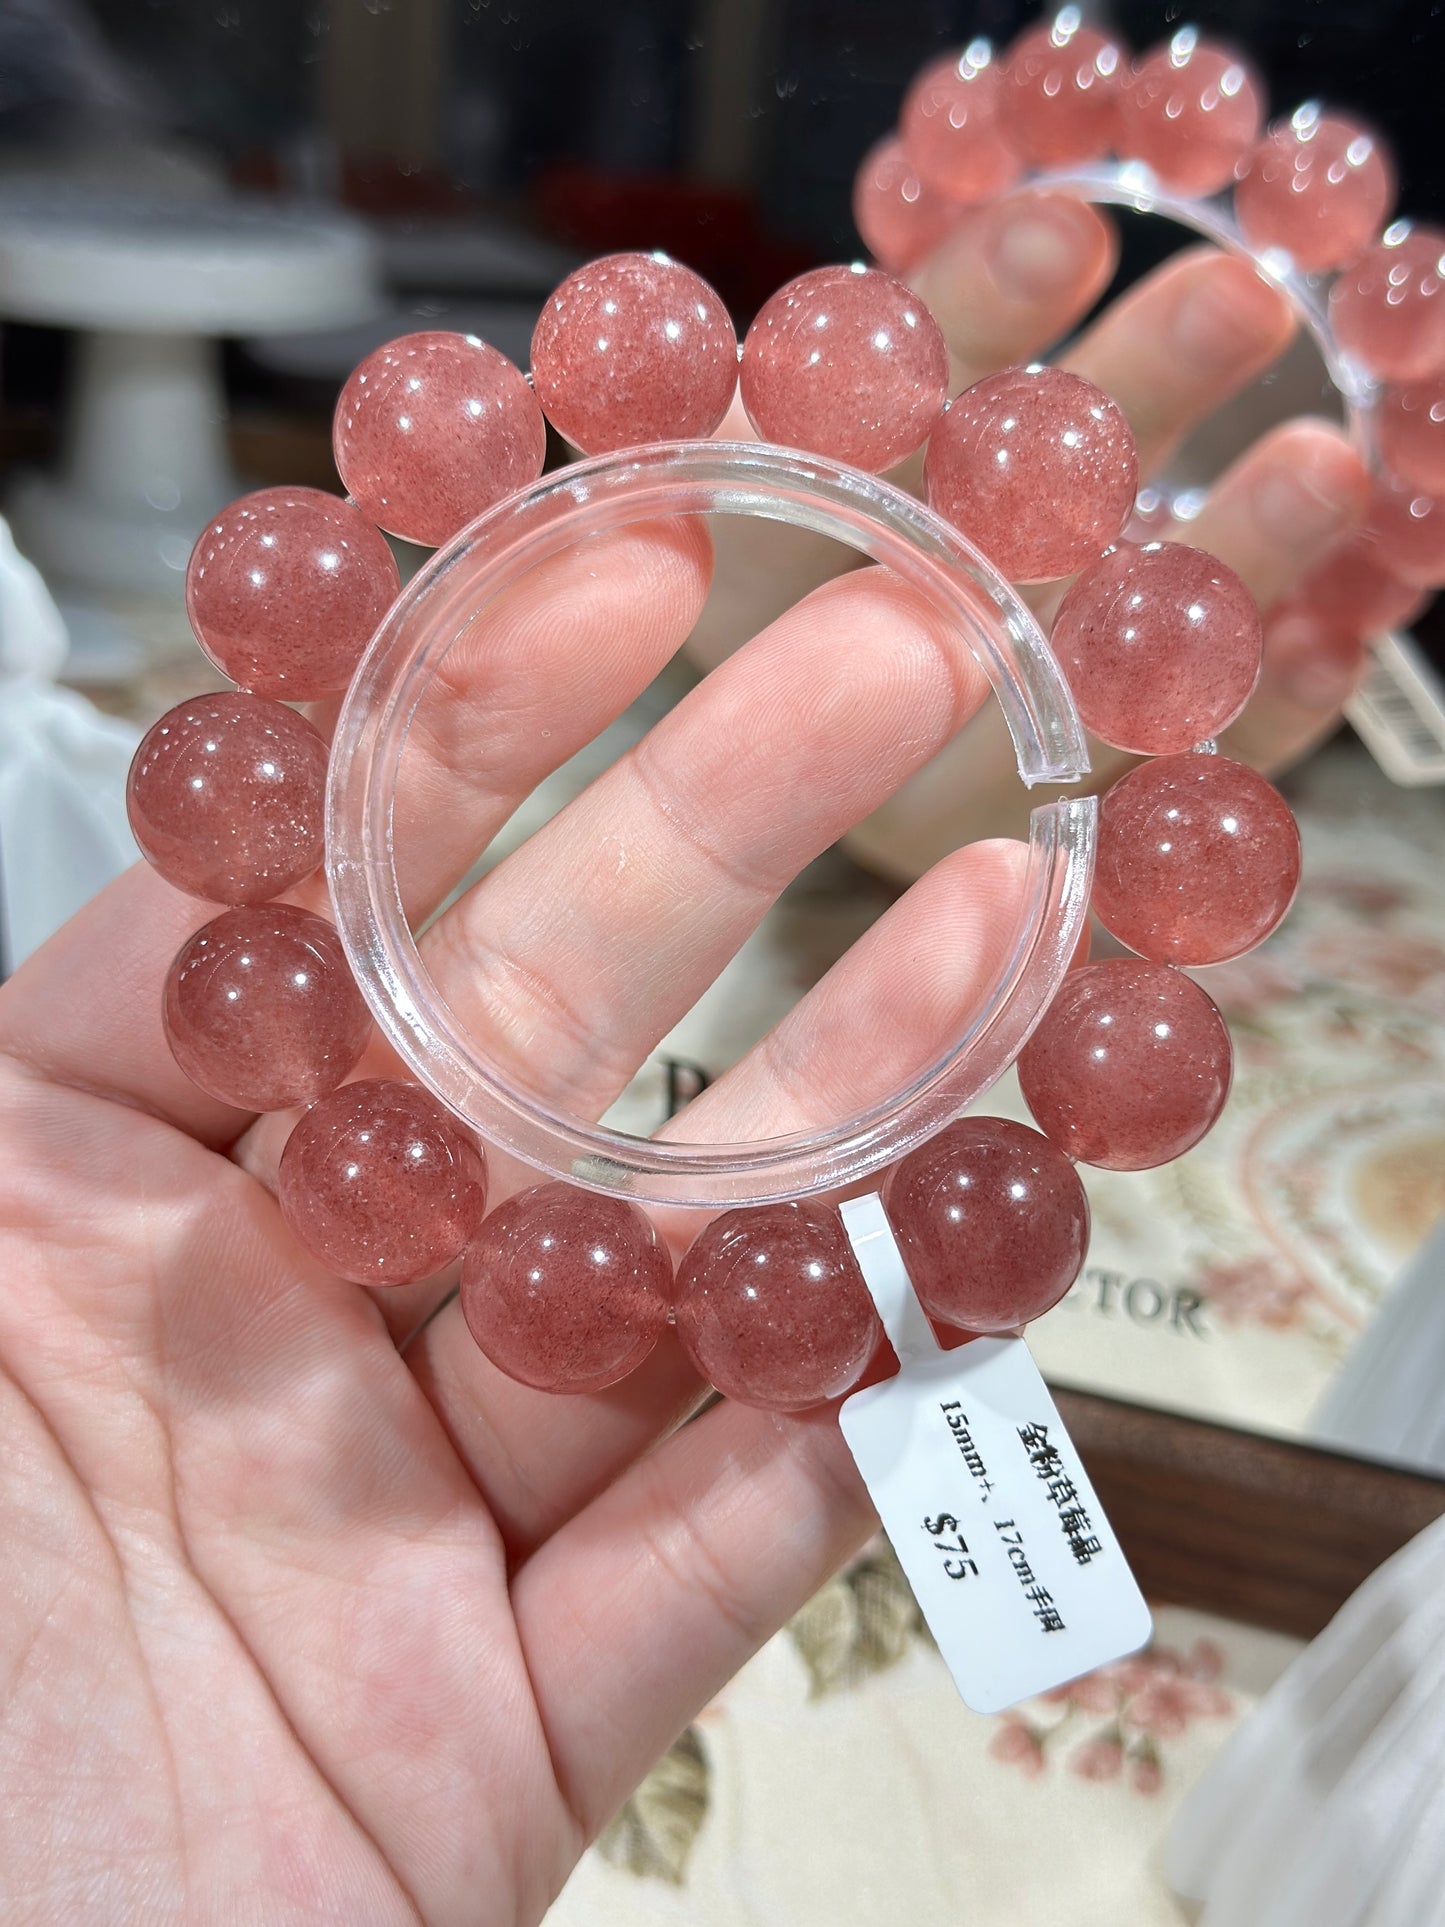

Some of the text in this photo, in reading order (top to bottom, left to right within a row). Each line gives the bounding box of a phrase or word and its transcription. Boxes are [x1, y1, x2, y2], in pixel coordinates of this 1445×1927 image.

[920, 1511, 979, 1581] $75
[1016, 1420, 1103, 1566] 金粉草莓晶
